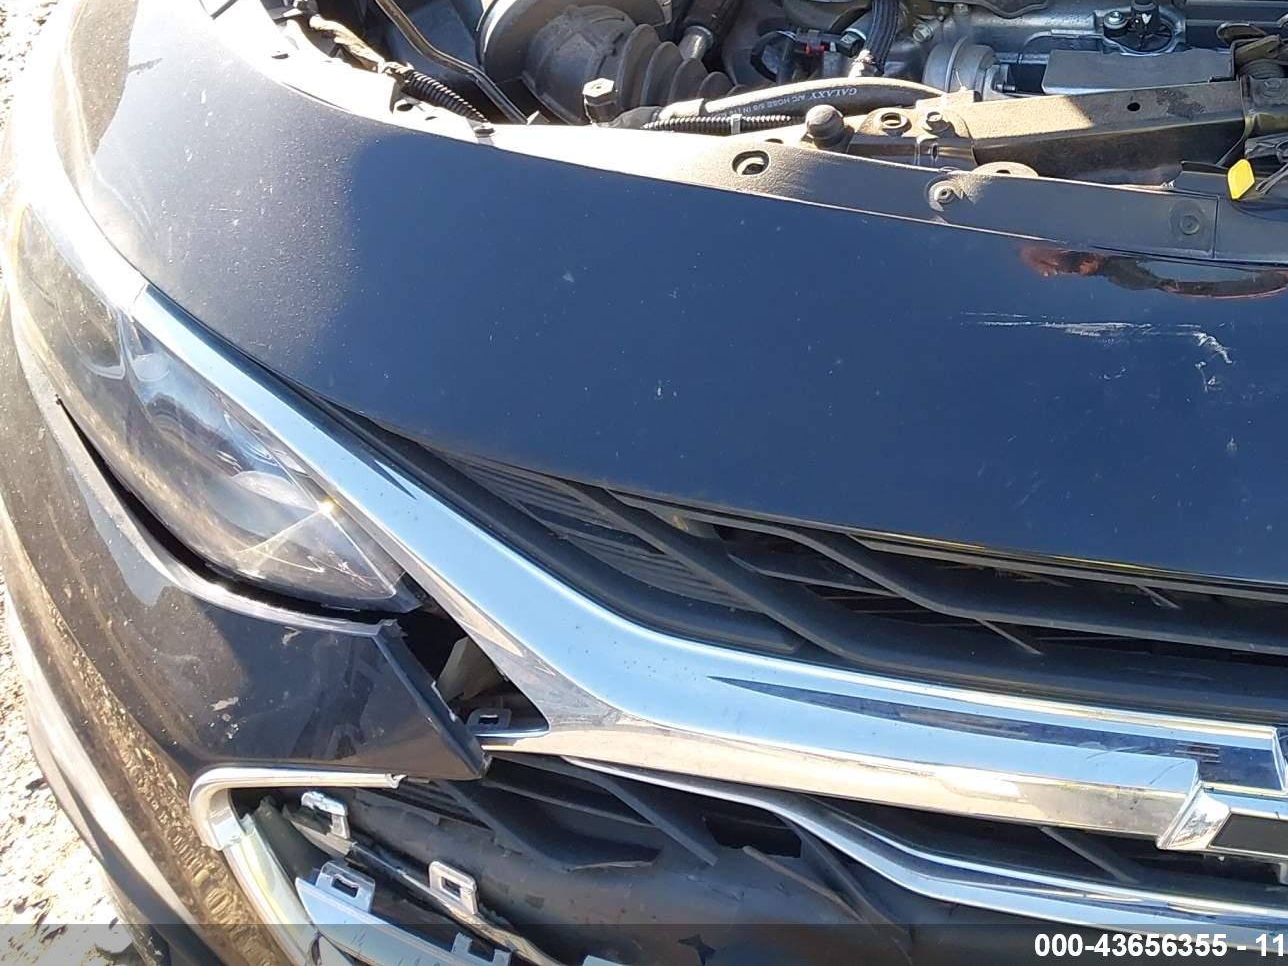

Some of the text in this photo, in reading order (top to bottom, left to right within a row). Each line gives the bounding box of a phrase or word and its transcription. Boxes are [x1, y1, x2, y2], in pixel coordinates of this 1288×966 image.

[791, 94, 806, 102] A/C
[810, 87, 857, 101] GALAXY
[767, 97, 790, 108] HOSE
